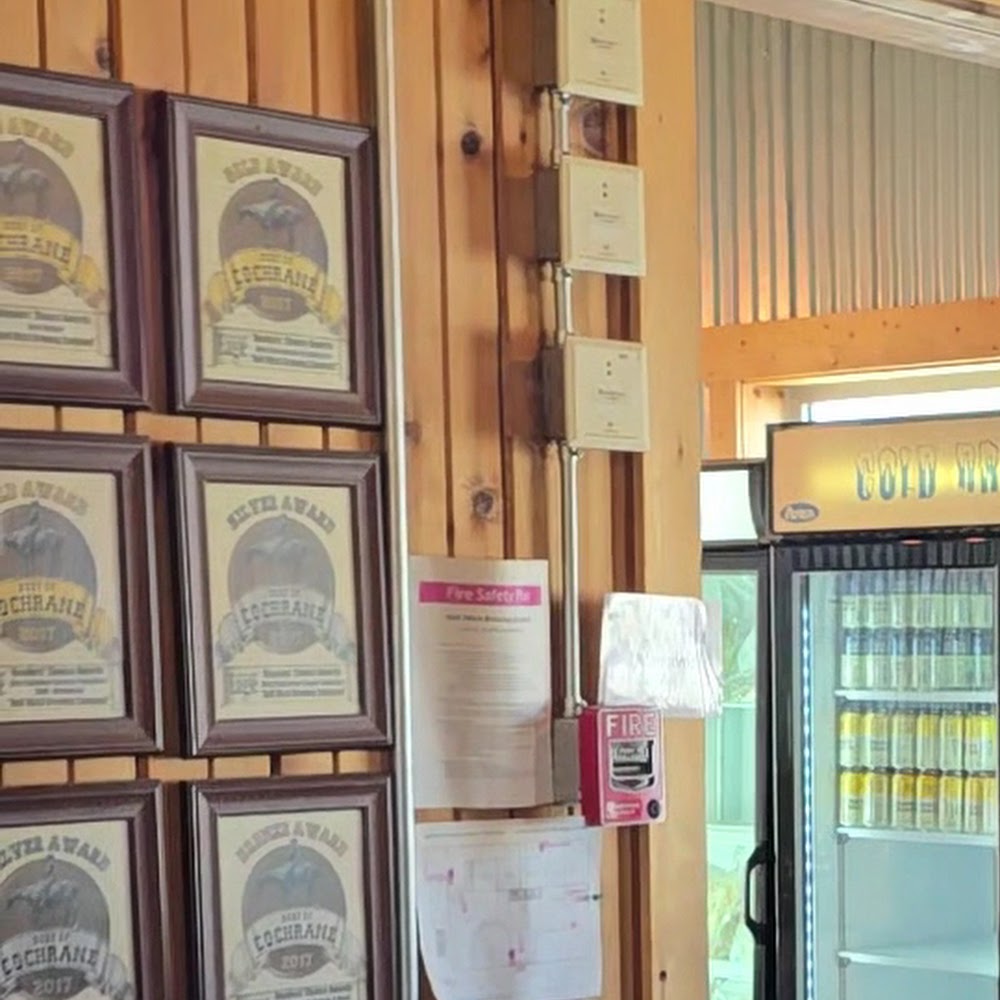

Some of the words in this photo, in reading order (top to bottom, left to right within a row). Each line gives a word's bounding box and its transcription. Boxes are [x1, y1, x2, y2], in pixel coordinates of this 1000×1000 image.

[856, 445, 936, 501] COLD
[605, 712, 656, 738] FIRE
[253, 923, 338, 952] COCHRANE
[1, 944, 99, 976] COCHRANE
